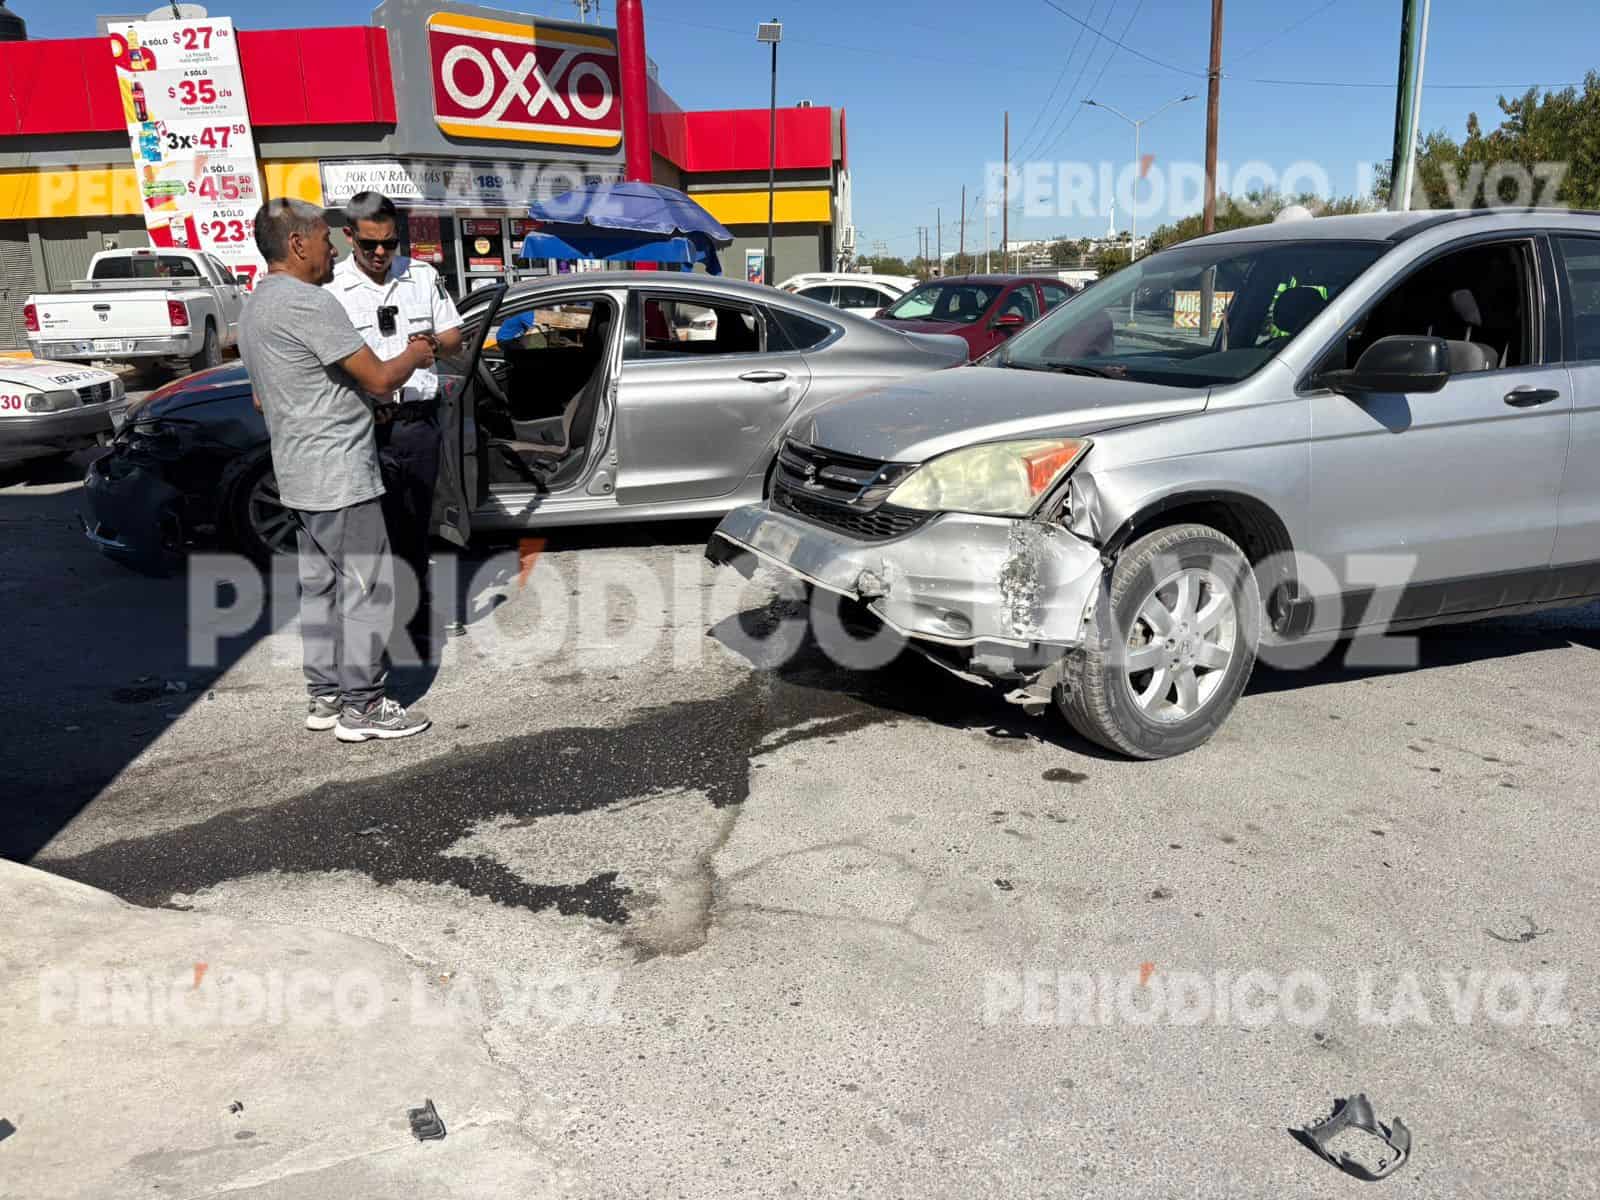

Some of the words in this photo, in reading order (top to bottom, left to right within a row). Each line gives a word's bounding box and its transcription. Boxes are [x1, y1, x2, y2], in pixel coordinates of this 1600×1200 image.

[441, 45, 613, 121] OXXO
[345, 170, 367, 182] POR
[370, 170, 386, 182] UN
[388, 170, 416, 182] RATO
[335, 184, 358, 195] CON
[361, 184, 379, 194] LOS
[382, 183, 425, 195] AMIGOS
